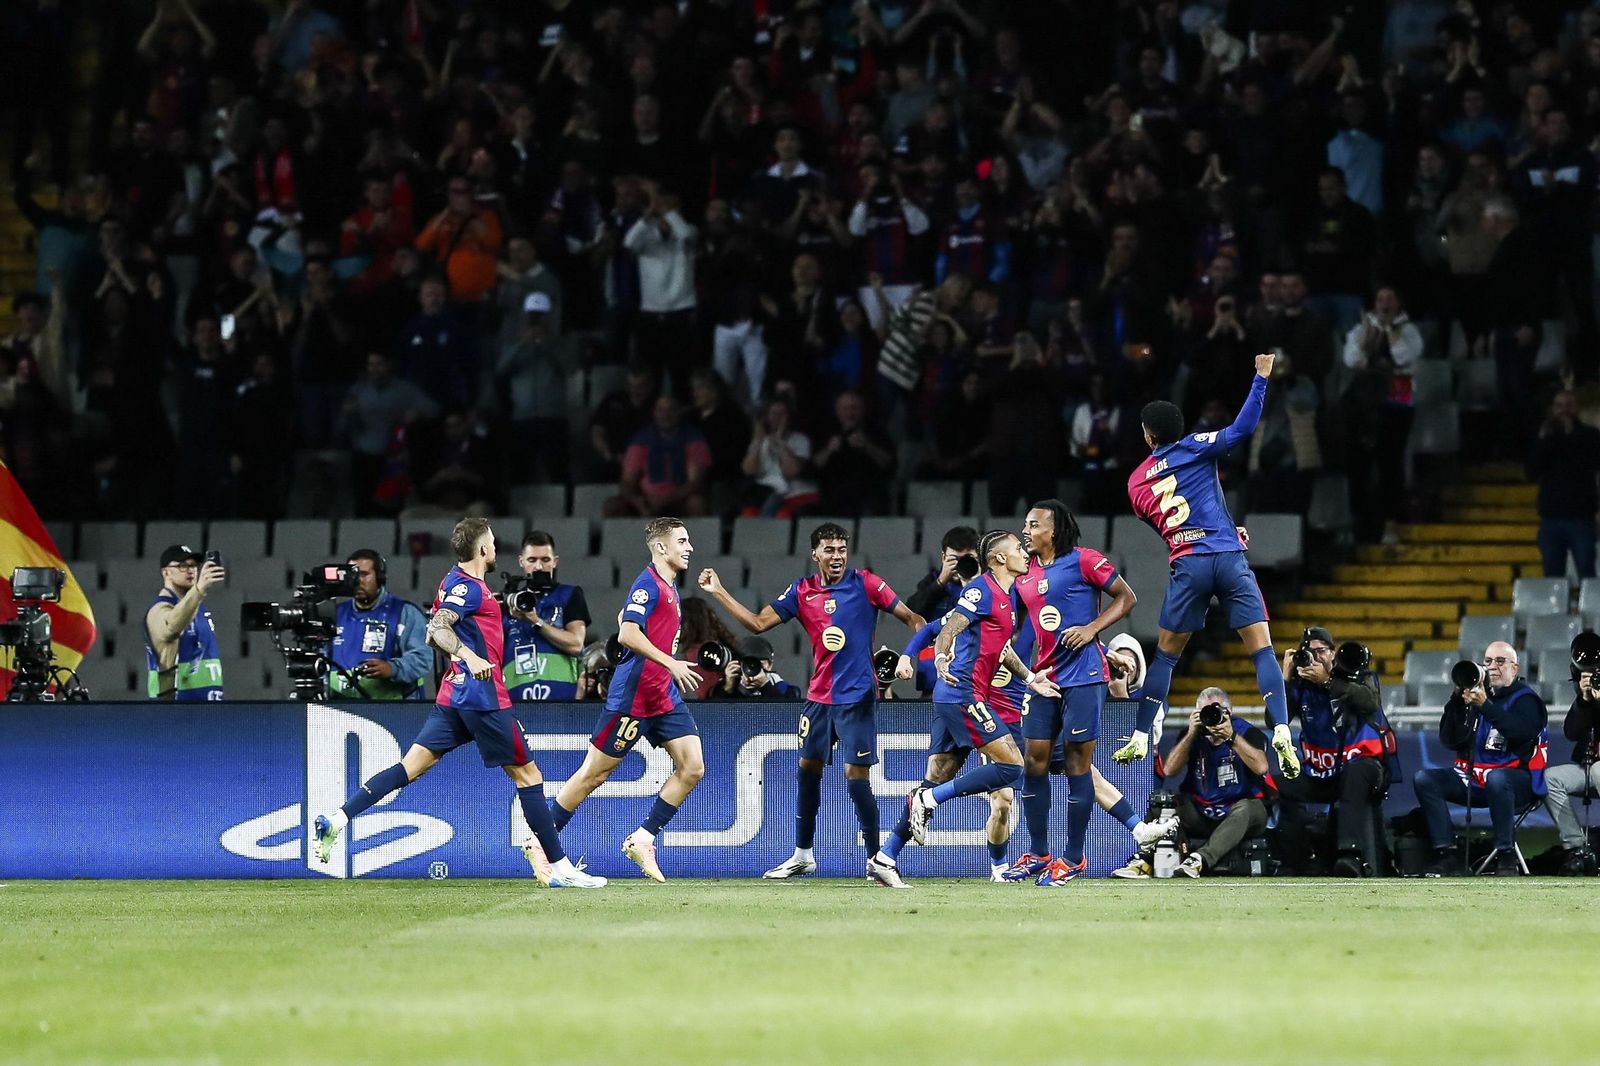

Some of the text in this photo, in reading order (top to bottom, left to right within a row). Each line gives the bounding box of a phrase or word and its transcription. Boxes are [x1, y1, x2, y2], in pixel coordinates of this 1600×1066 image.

[1150, 473, 1191, 528] 3
[967, 701, 993, 723] 11
[616, 716, 640, 741] 16
[1302, 743, 1361, 770] PHO
[510, 732, 1020, 847] PS5
